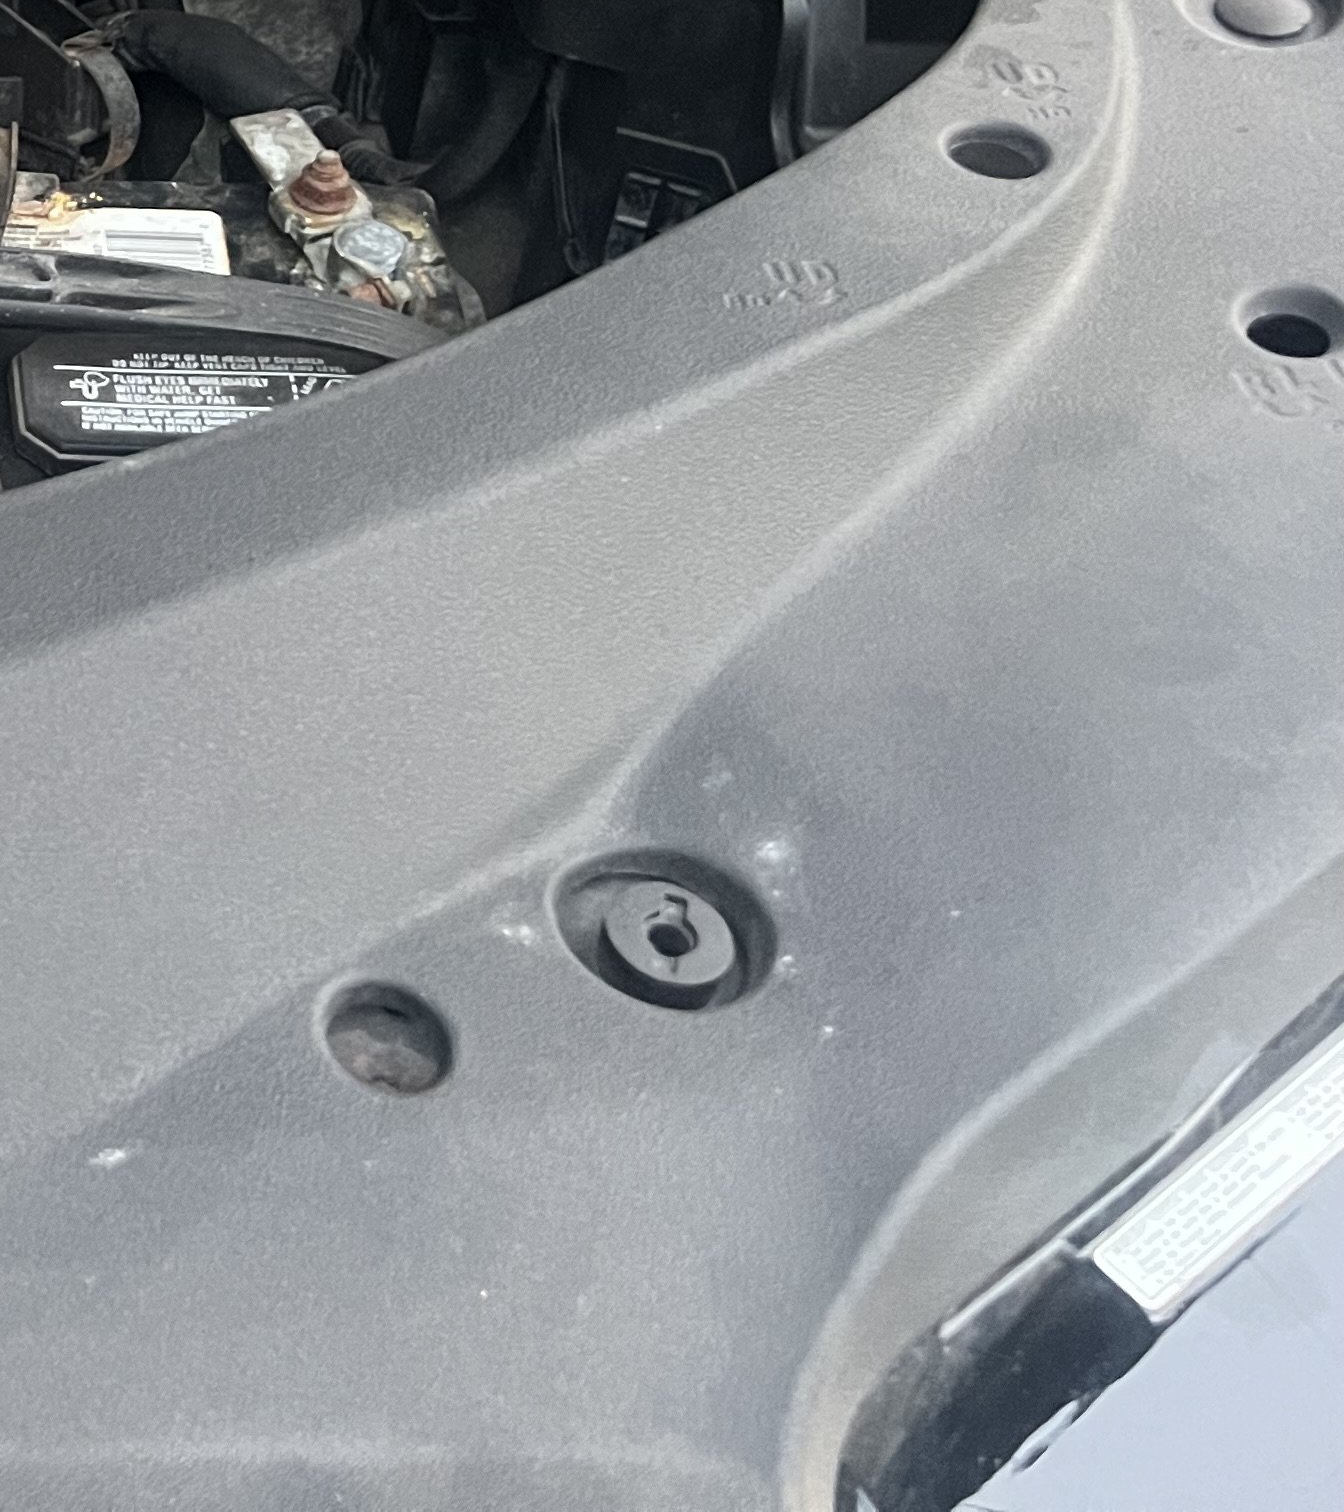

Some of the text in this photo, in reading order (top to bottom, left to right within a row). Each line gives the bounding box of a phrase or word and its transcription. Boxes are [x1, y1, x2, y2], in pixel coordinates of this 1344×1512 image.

[113, 384, 147, 394] WITH
[115, 393, 236, 405] MEDICAL HELP FAST
